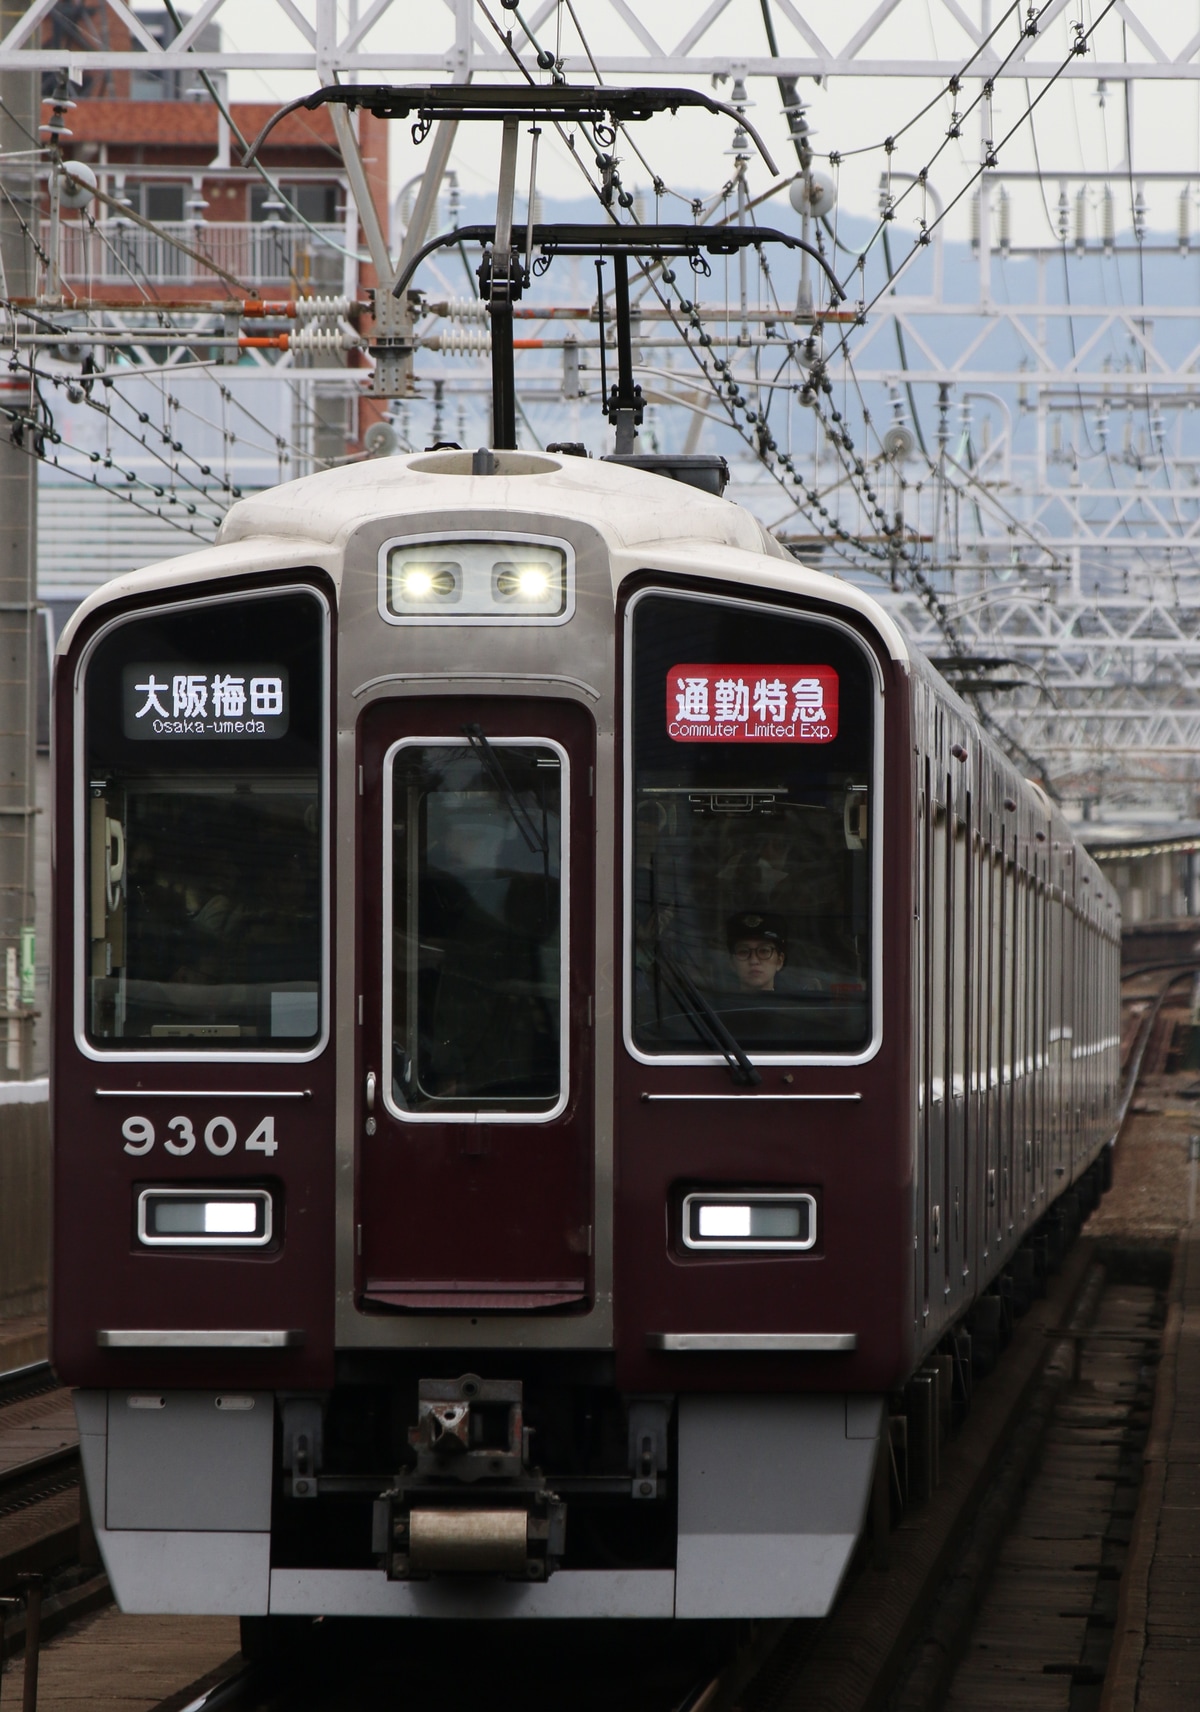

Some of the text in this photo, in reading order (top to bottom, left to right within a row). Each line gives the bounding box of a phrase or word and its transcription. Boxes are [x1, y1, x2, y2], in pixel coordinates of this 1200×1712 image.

[134, 674, 283, 719] 大阪梅田
[675, 677, 827, 723] 通勤特急
[152, 719, 266, 734] Osaka-umeda
[668, 722, 833, 740] Commuter Limited Exp.
[121, 1116, 279, 1157] 9304
